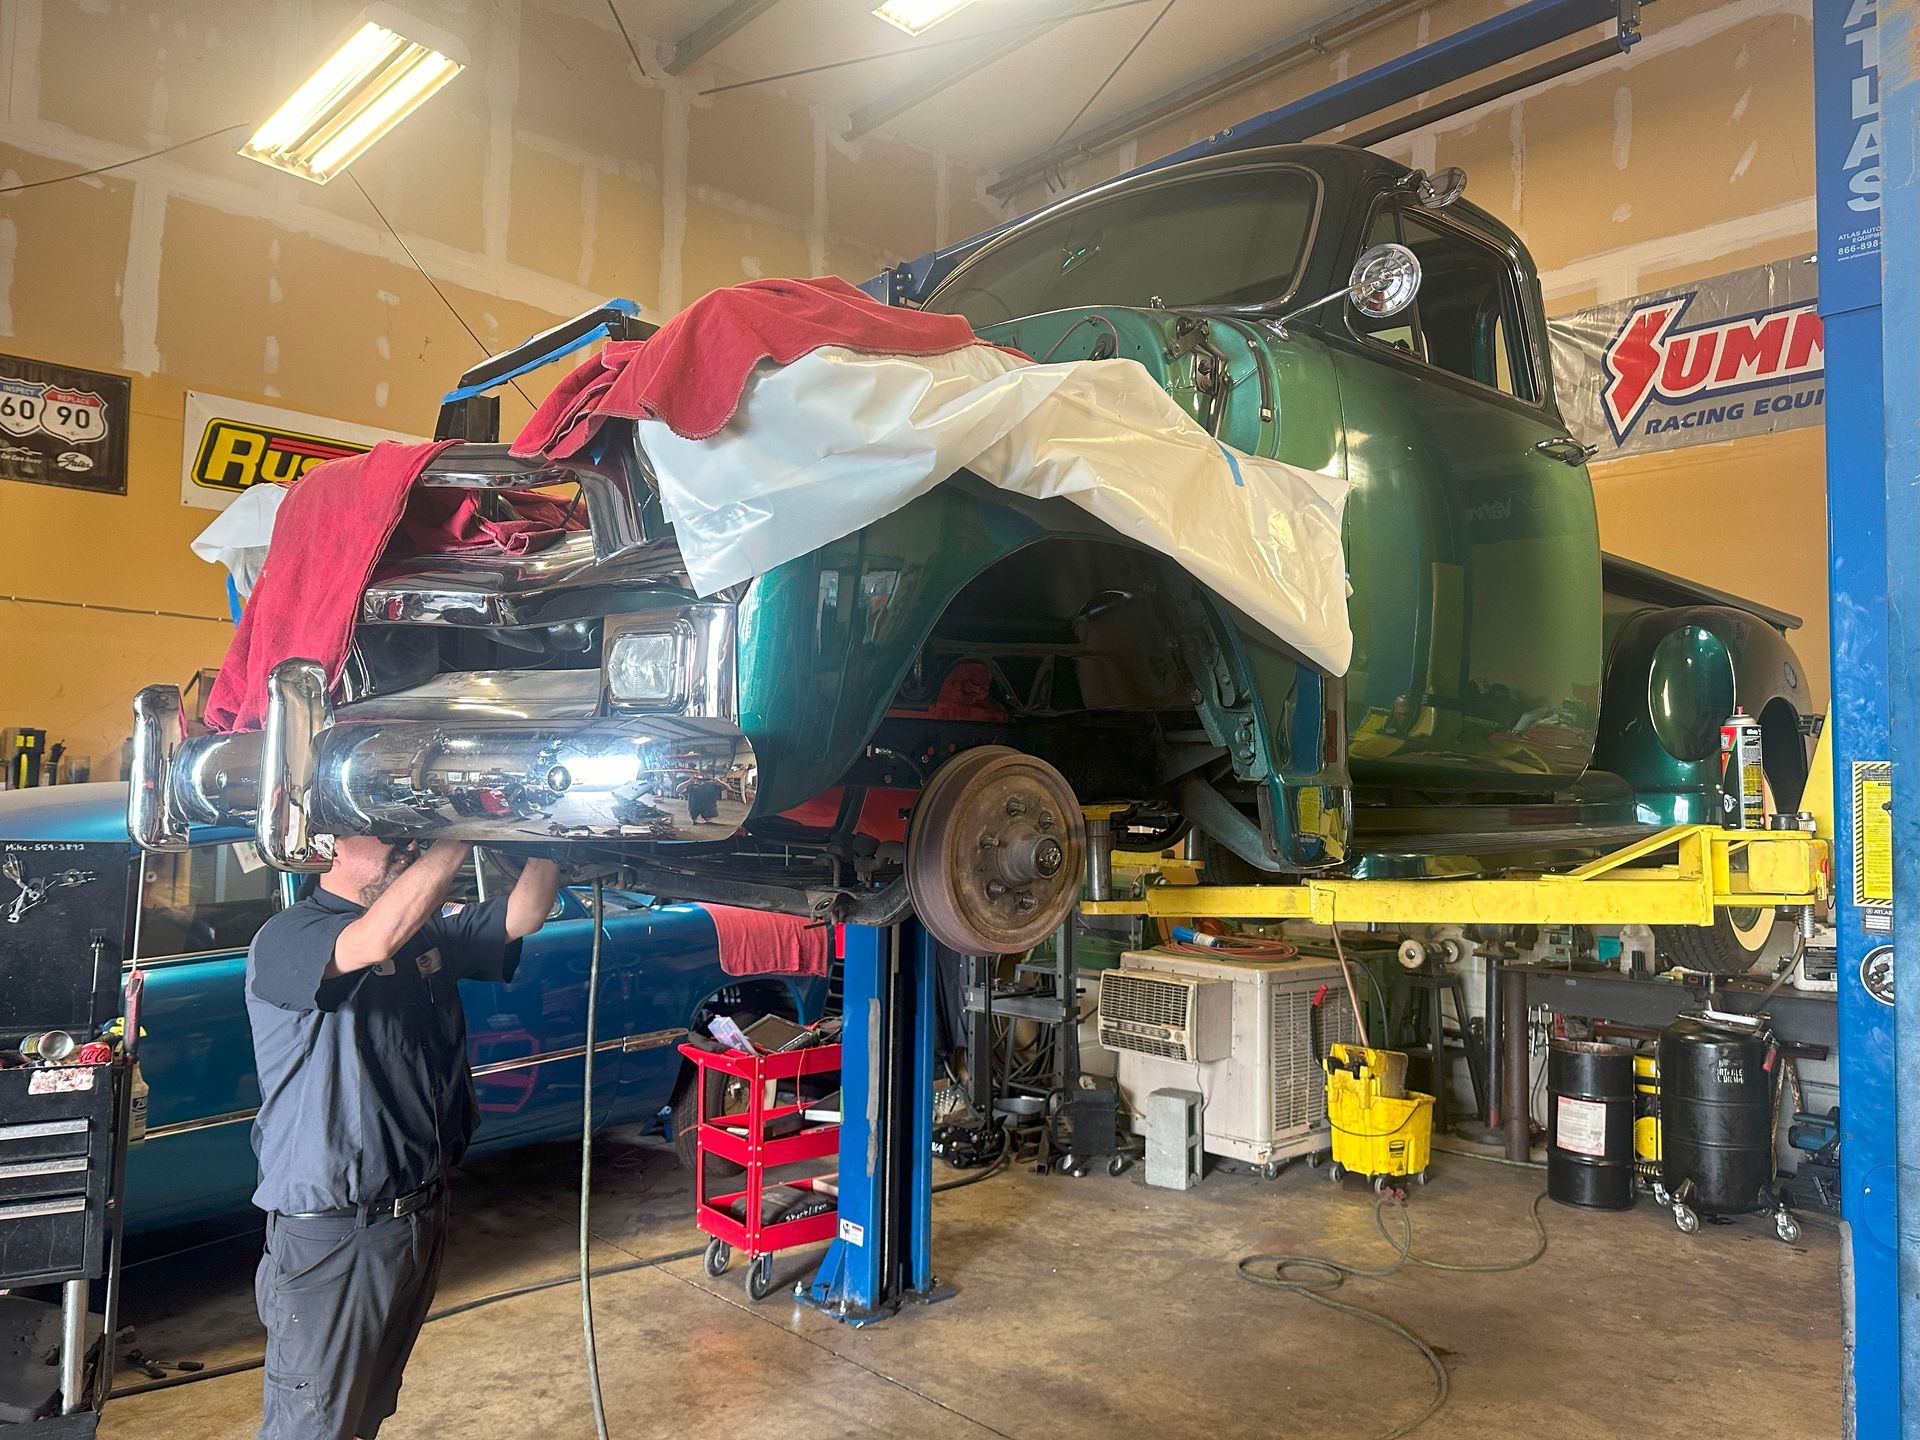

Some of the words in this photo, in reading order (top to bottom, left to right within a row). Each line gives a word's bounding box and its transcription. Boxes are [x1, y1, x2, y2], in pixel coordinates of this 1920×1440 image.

[1838, 230, 1861, 241] ATLAS
[2, 384, 35, 397] INSPECT
[57, 393, 91, 406] REPLACE
[0, 396, 34, 420] 60
[57, 405, 90, 429] 90
[1645, 402, 1745, 435] RACING
